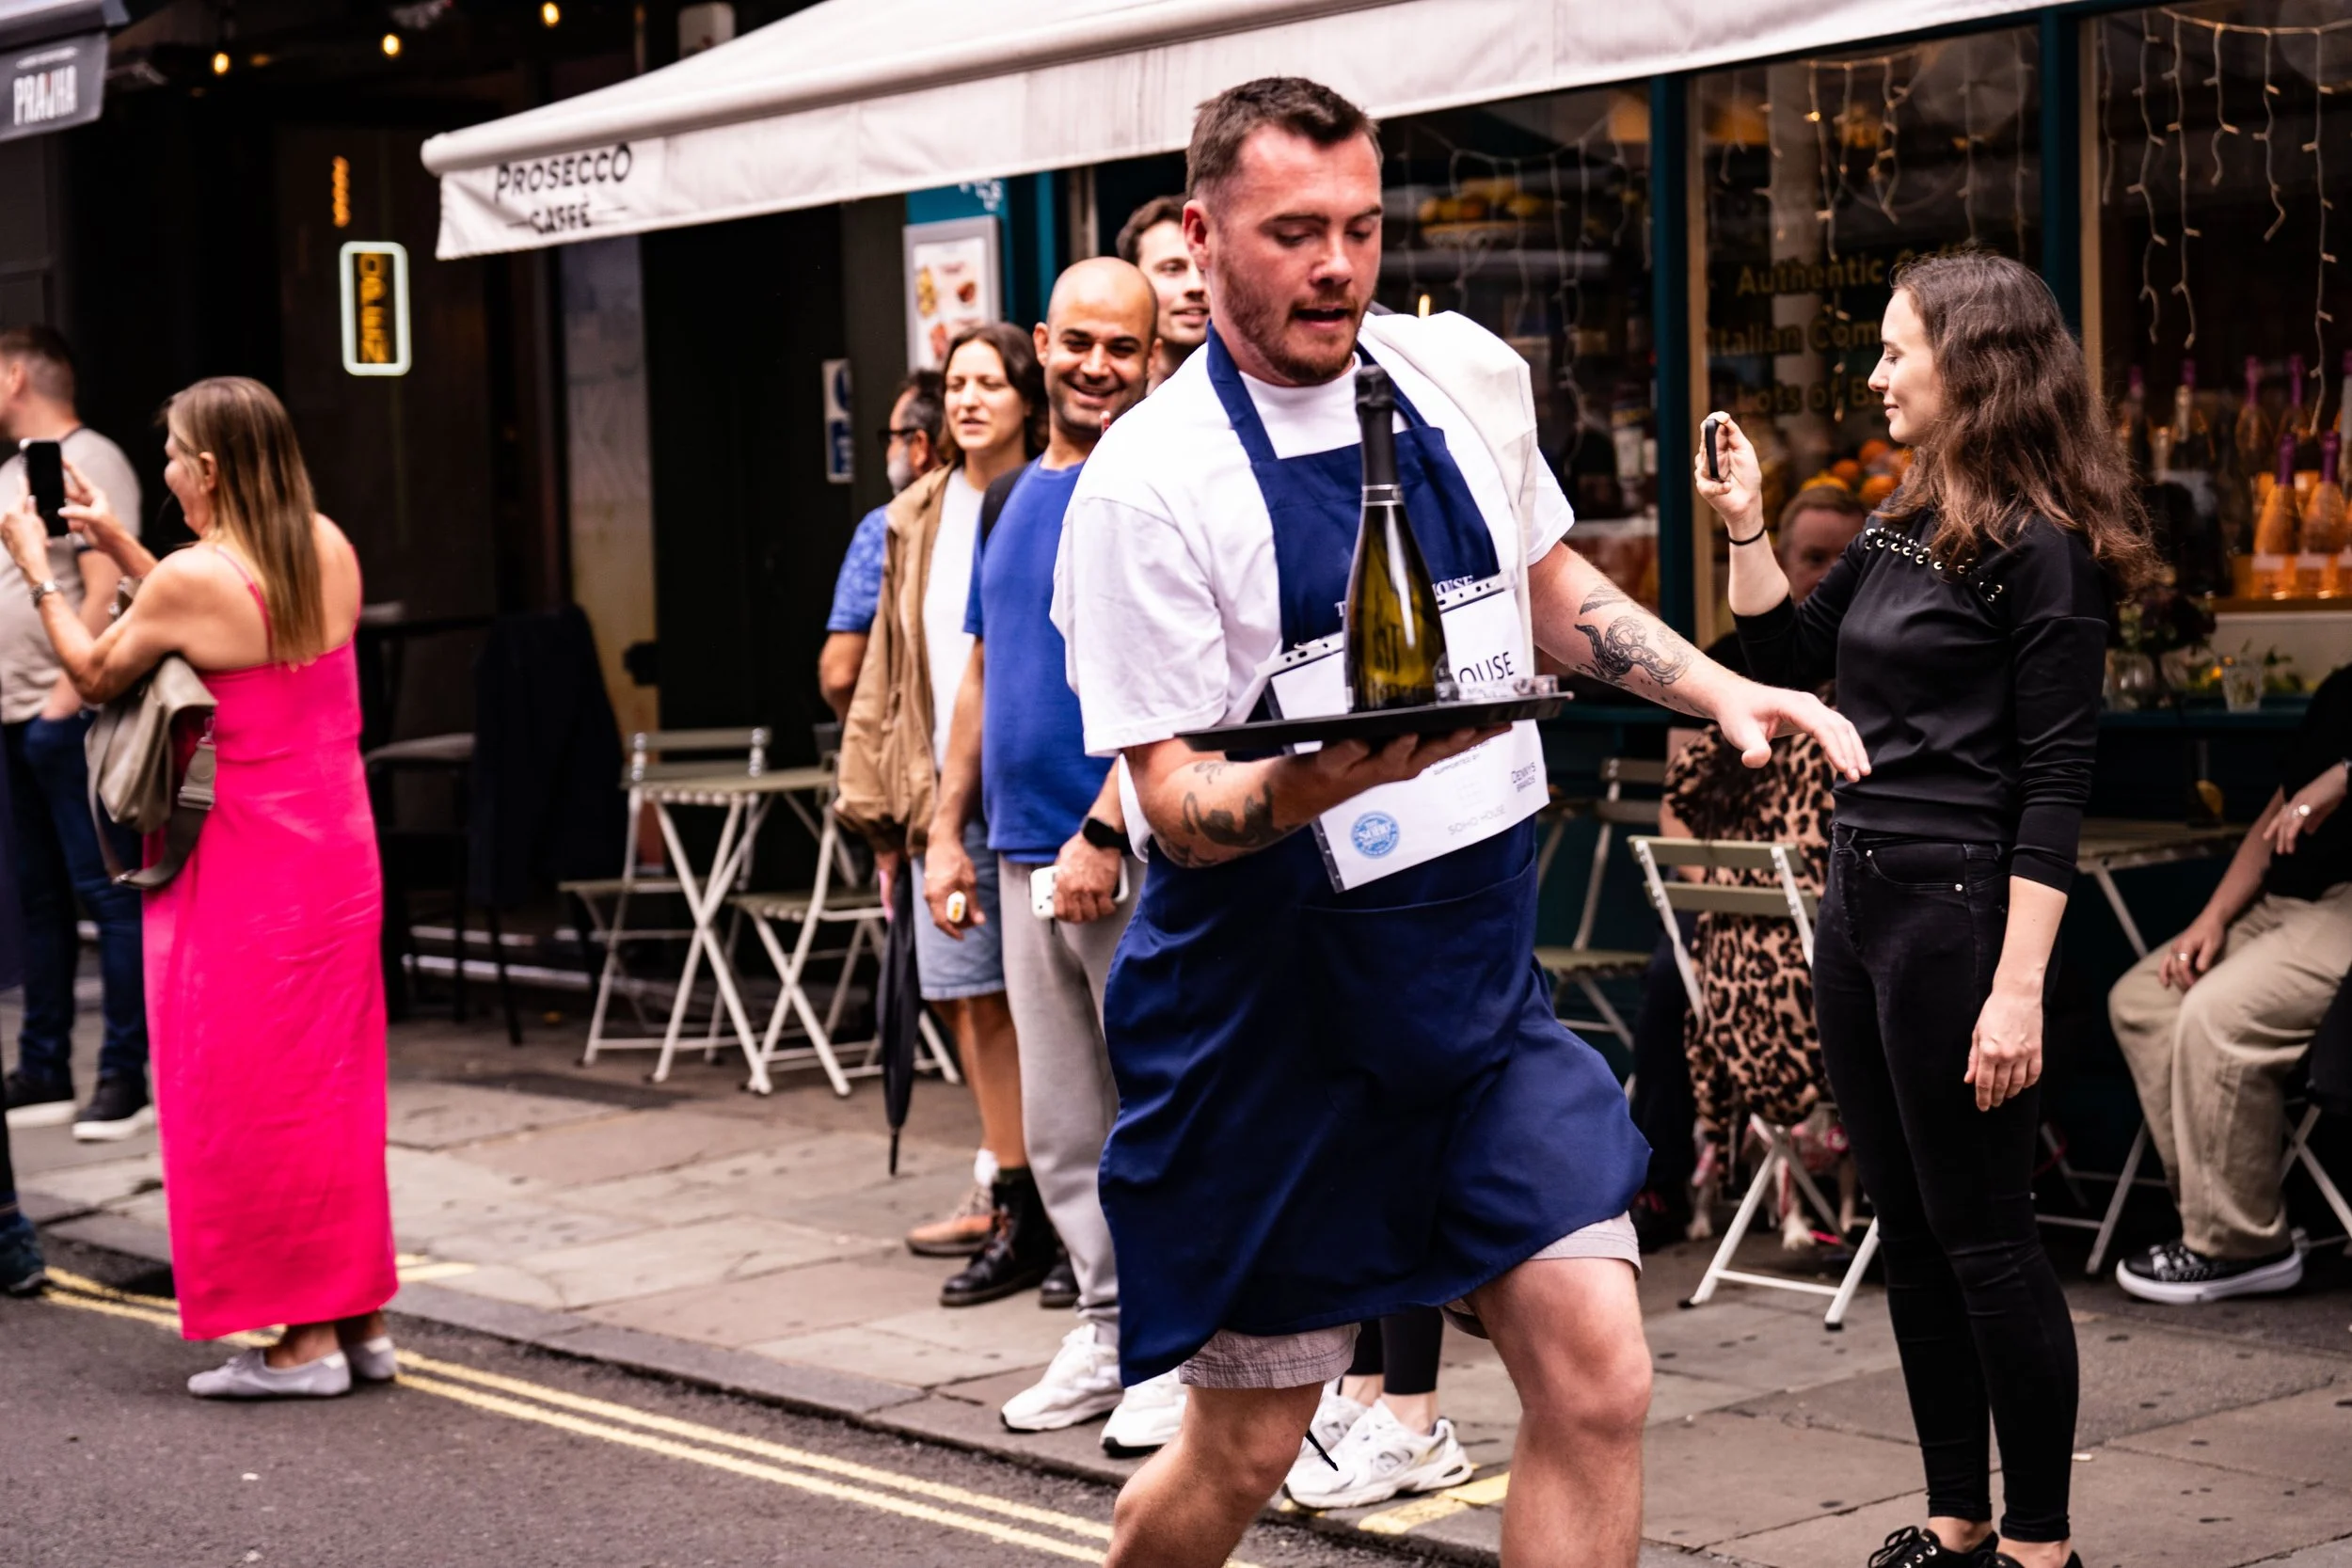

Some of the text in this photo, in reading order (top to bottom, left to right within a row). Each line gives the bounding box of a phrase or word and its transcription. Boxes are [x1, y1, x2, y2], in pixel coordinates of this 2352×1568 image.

[495, 142, 631, 203] PROSECCO
[1737, 251, 1884, 297] Authentic
[358, 252, 389, 363] OPEN
[1458, 651, 1515, 683] OUSE
[1448, 816, 1479, 835] SOHO
